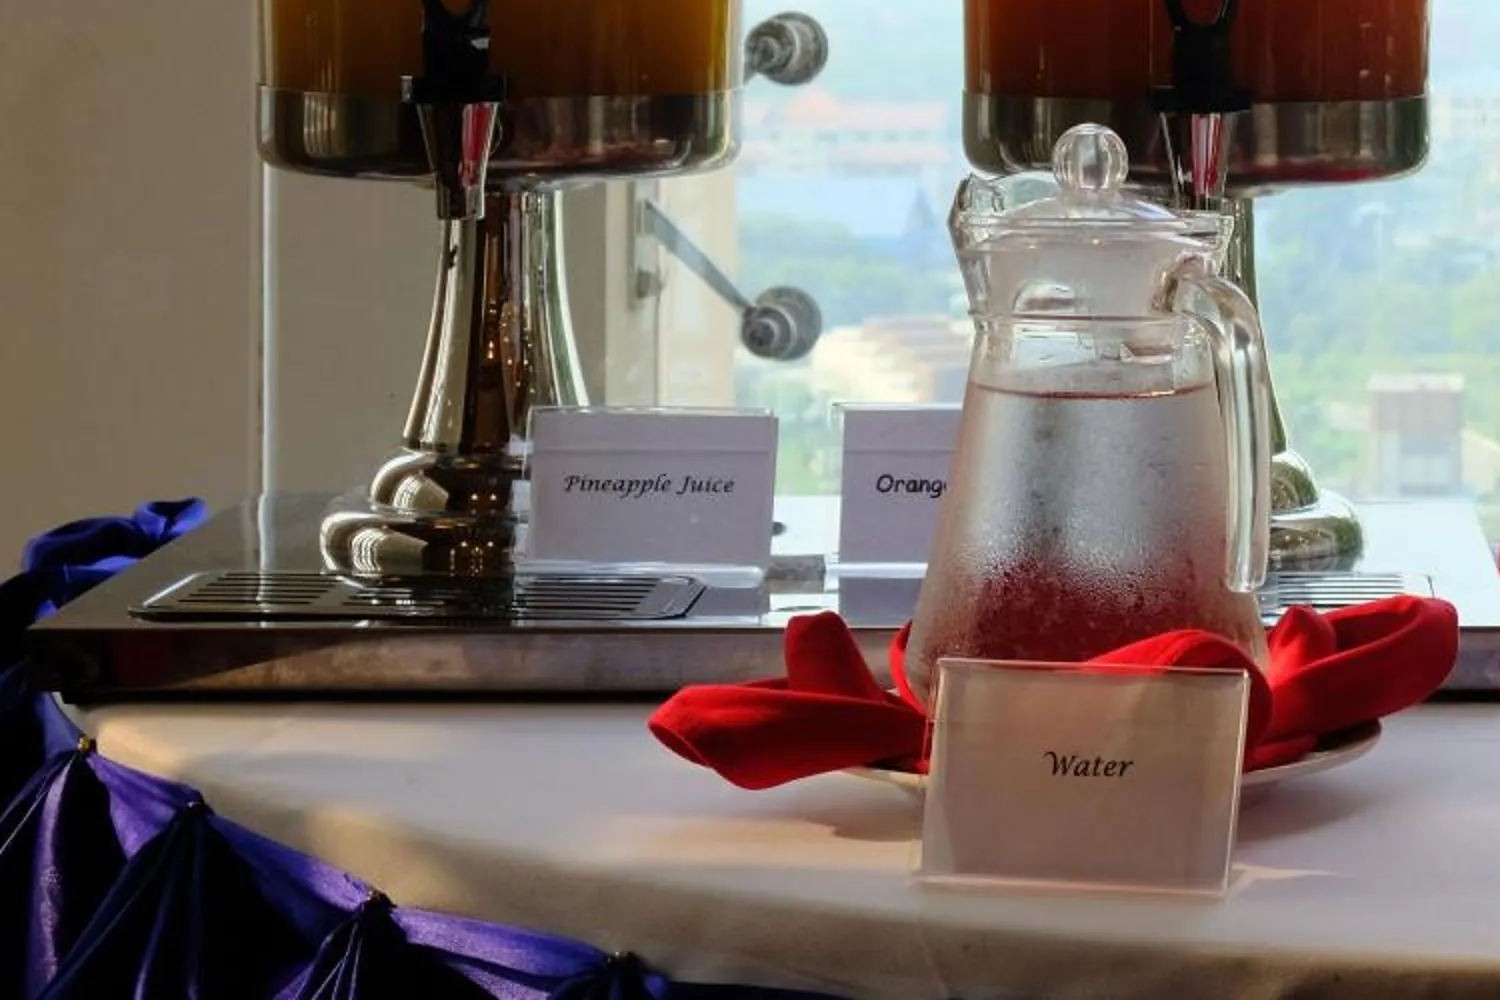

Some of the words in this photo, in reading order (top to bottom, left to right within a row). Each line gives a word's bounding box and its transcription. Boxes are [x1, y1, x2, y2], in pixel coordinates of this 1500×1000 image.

[564, 473, 671, 498] Pineapple
[676, 475, 735, 494] Juice
[876, 474, 946, 498] Orang
[1044, 751, 1134, 777] Water
